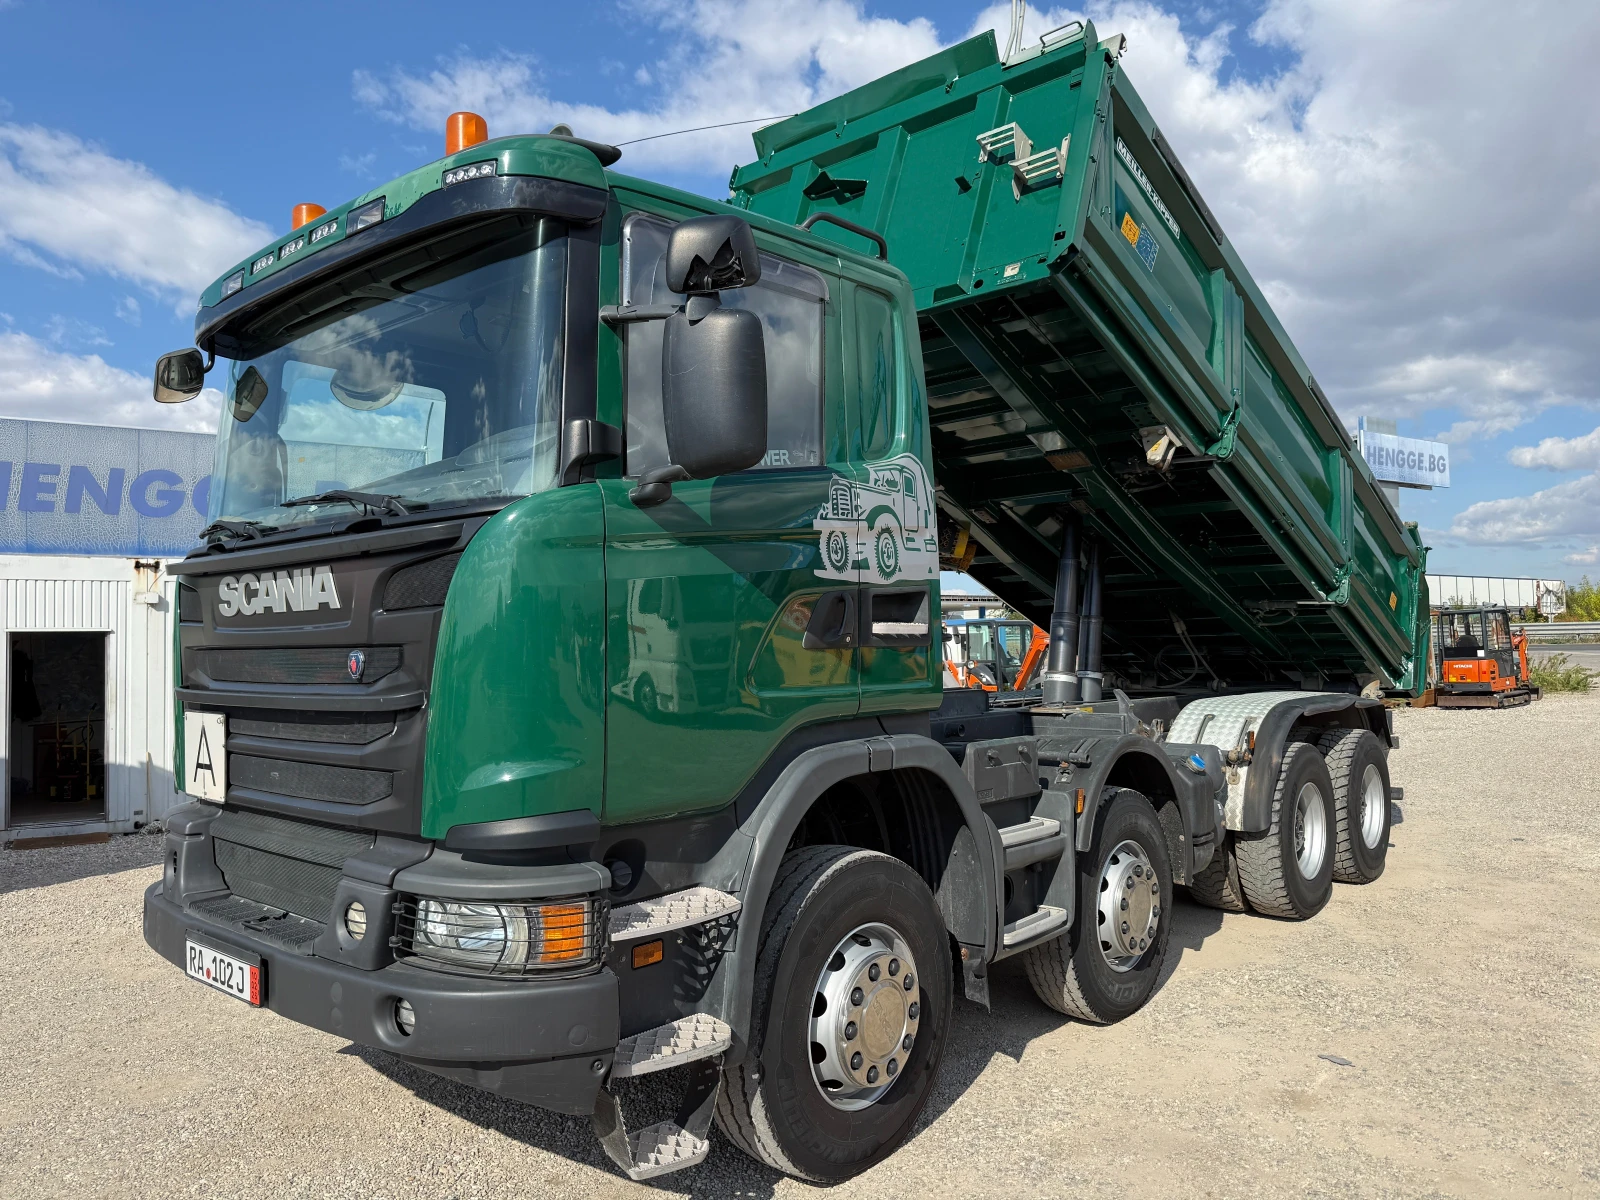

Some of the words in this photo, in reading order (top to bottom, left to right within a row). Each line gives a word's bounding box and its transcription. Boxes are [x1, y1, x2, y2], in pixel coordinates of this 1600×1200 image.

[1118, 141, 1179, 233] MEILLER-KIPPER
[1366, 446, 1447, 474] HENGGE.BG
[0, 461, 212, 518] ENG
[218, 565, 342, 617] SCANIA
[193, 724, 217, 787] A
